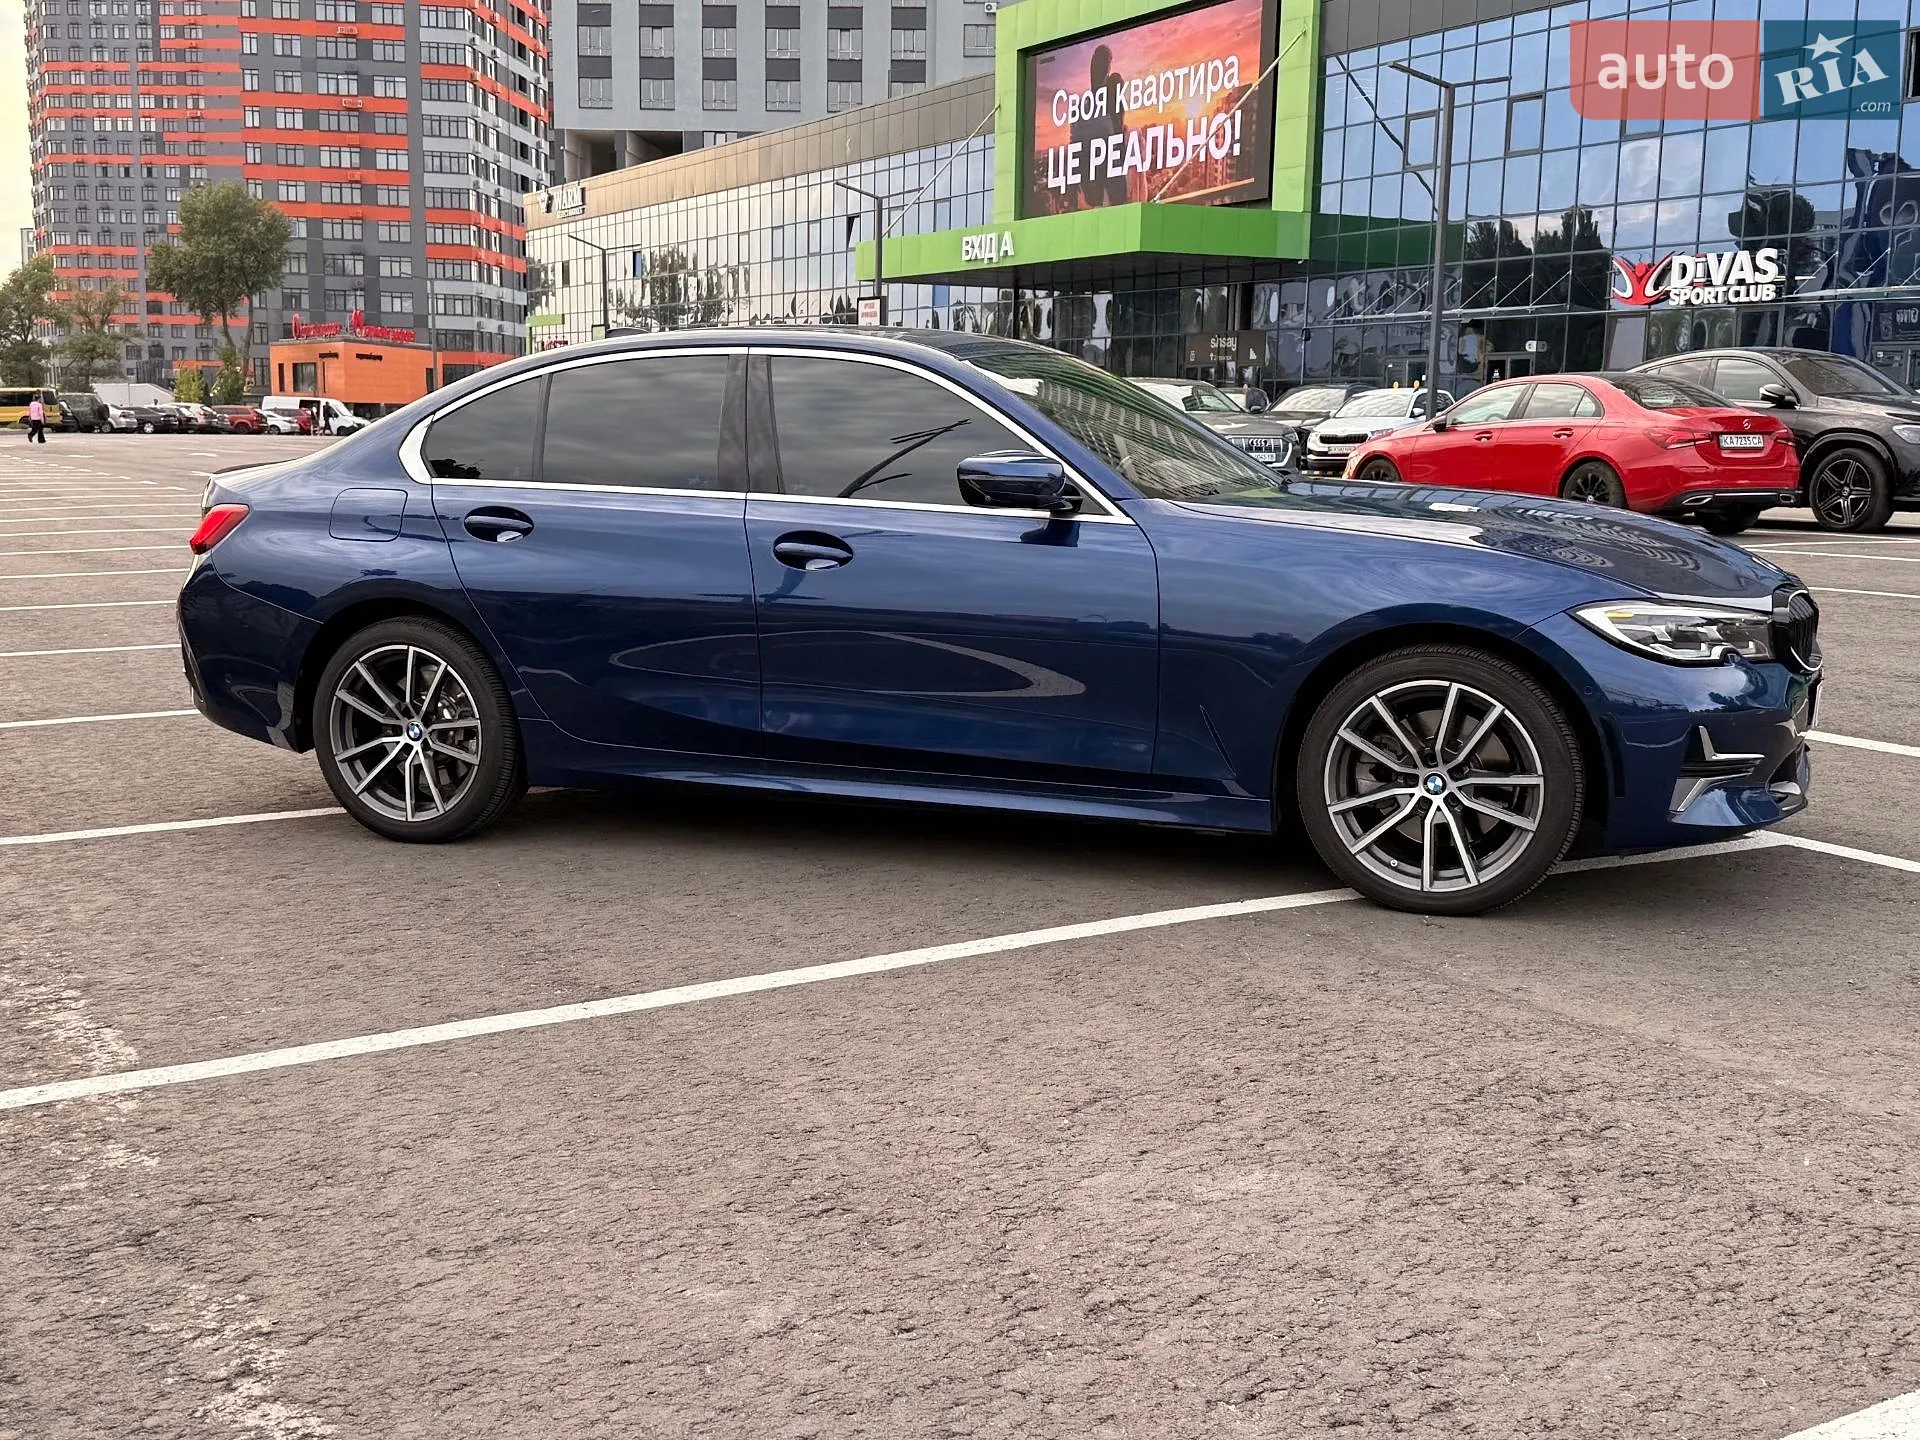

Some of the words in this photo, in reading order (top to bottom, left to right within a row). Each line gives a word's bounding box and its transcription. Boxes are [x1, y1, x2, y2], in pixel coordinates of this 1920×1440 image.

[1052, 86, 1108, 127] Своя
[1115, 55, 1240, 114] квартира
[1047, 142, 1082, 195] ЦЕ
[1089, 109, 1242, 181] РЕАЛЬНО!
[553, 187, 583, 210] WARM
[961, 232, 999, 264] ВХІД
[1000, 230, 1015, 257] А
[1668, 286, 1729, 306] SPORT
[1728, 284, 1777, 303] CLUB
[1210, 334, 1237, 351] sinsay
